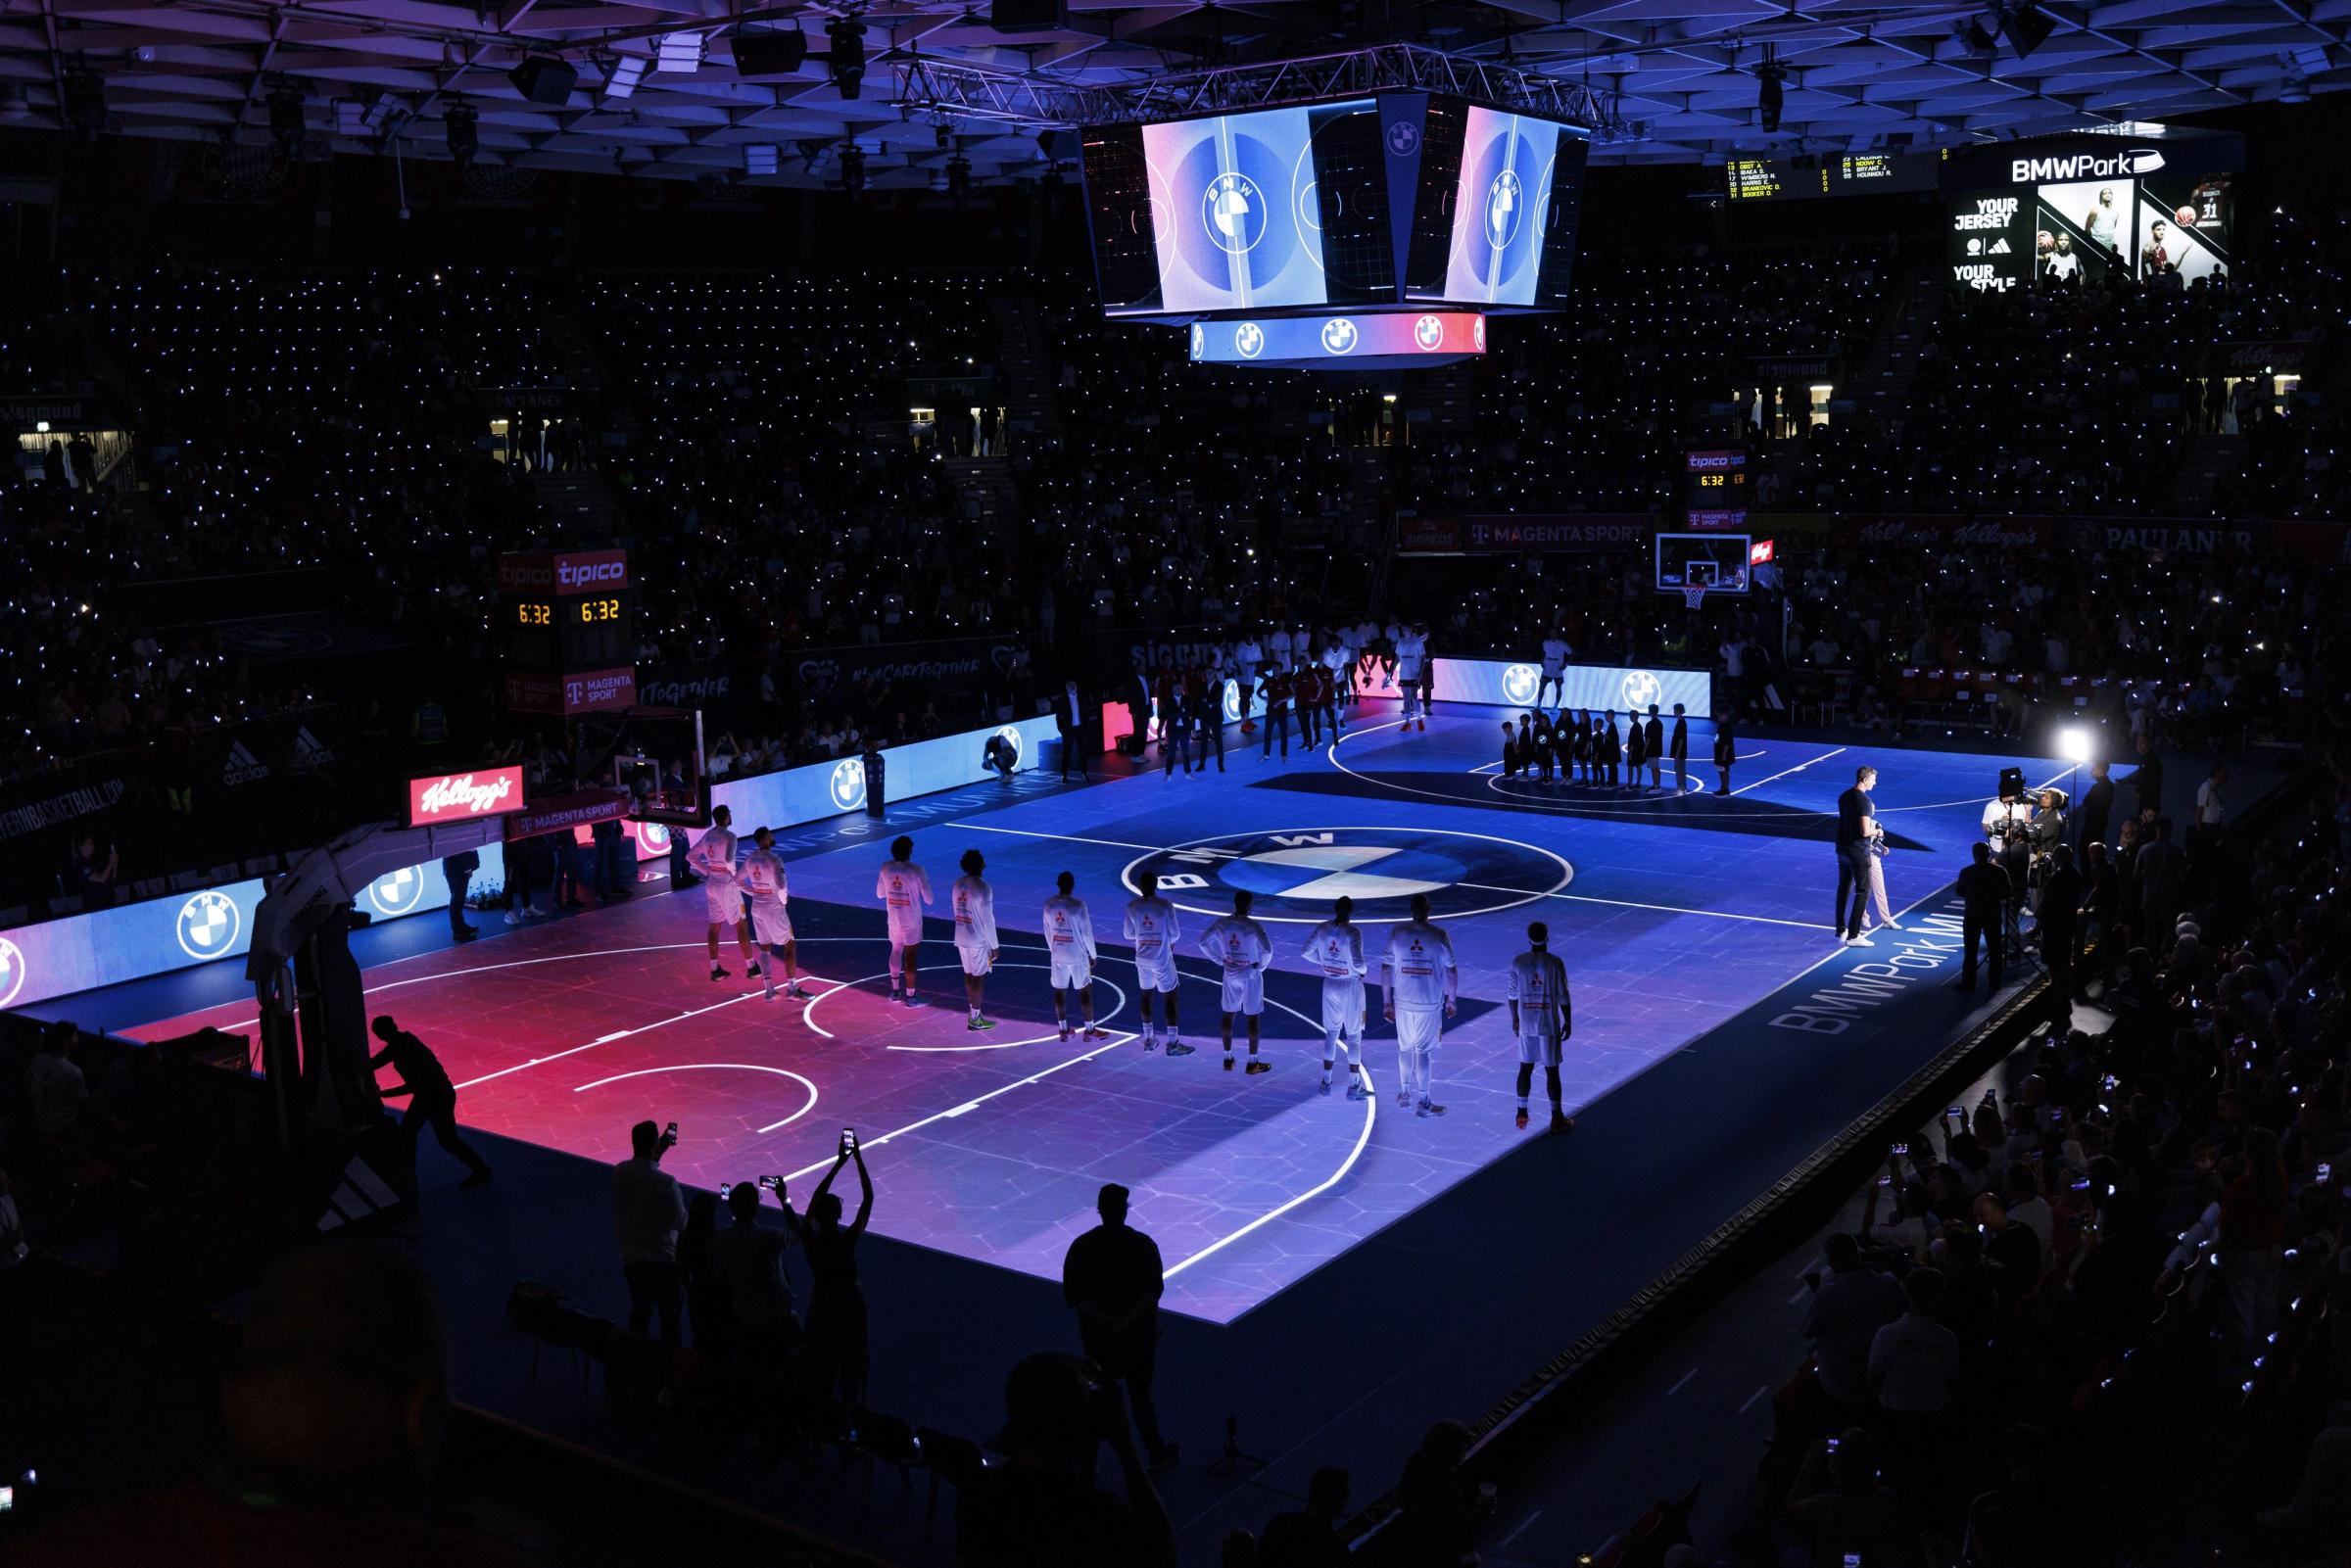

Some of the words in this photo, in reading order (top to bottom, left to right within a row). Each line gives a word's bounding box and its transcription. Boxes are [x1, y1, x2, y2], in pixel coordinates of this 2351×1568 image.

[2013, 153, 2131, 182] BMWPark
[1209, 177, 1253, 202] BMW
[1977, 198, 2018, 214] YOUR
[1955, 212, 2012, 230] JERSEY
[1953, 264, 1994, 281] YOUR
[1689, 454, 1728, 469] tipico
[1701, 475, 1725, 487] 6:32
[1494, 525, 1580, 542] MAGENTA
[1585, 525, 1644, 541] SPORT
[557, 561, 624, 587] tipico
[519, 604, 551, 624] 6:32
[581, 599, 620, 622] 6:32
[588, 675, 632, 690] MAGENTA
[588, 688, 617, 703] SPORT
[421, 774, 512, 813] Kellogg's
[534, 811, 585, 829] MAGENTA
[586, 802, 618, 819] SPORT
[1157, 832, 1334, 889] BMW
[1767, 938, 1965, 1036] BMWPark
